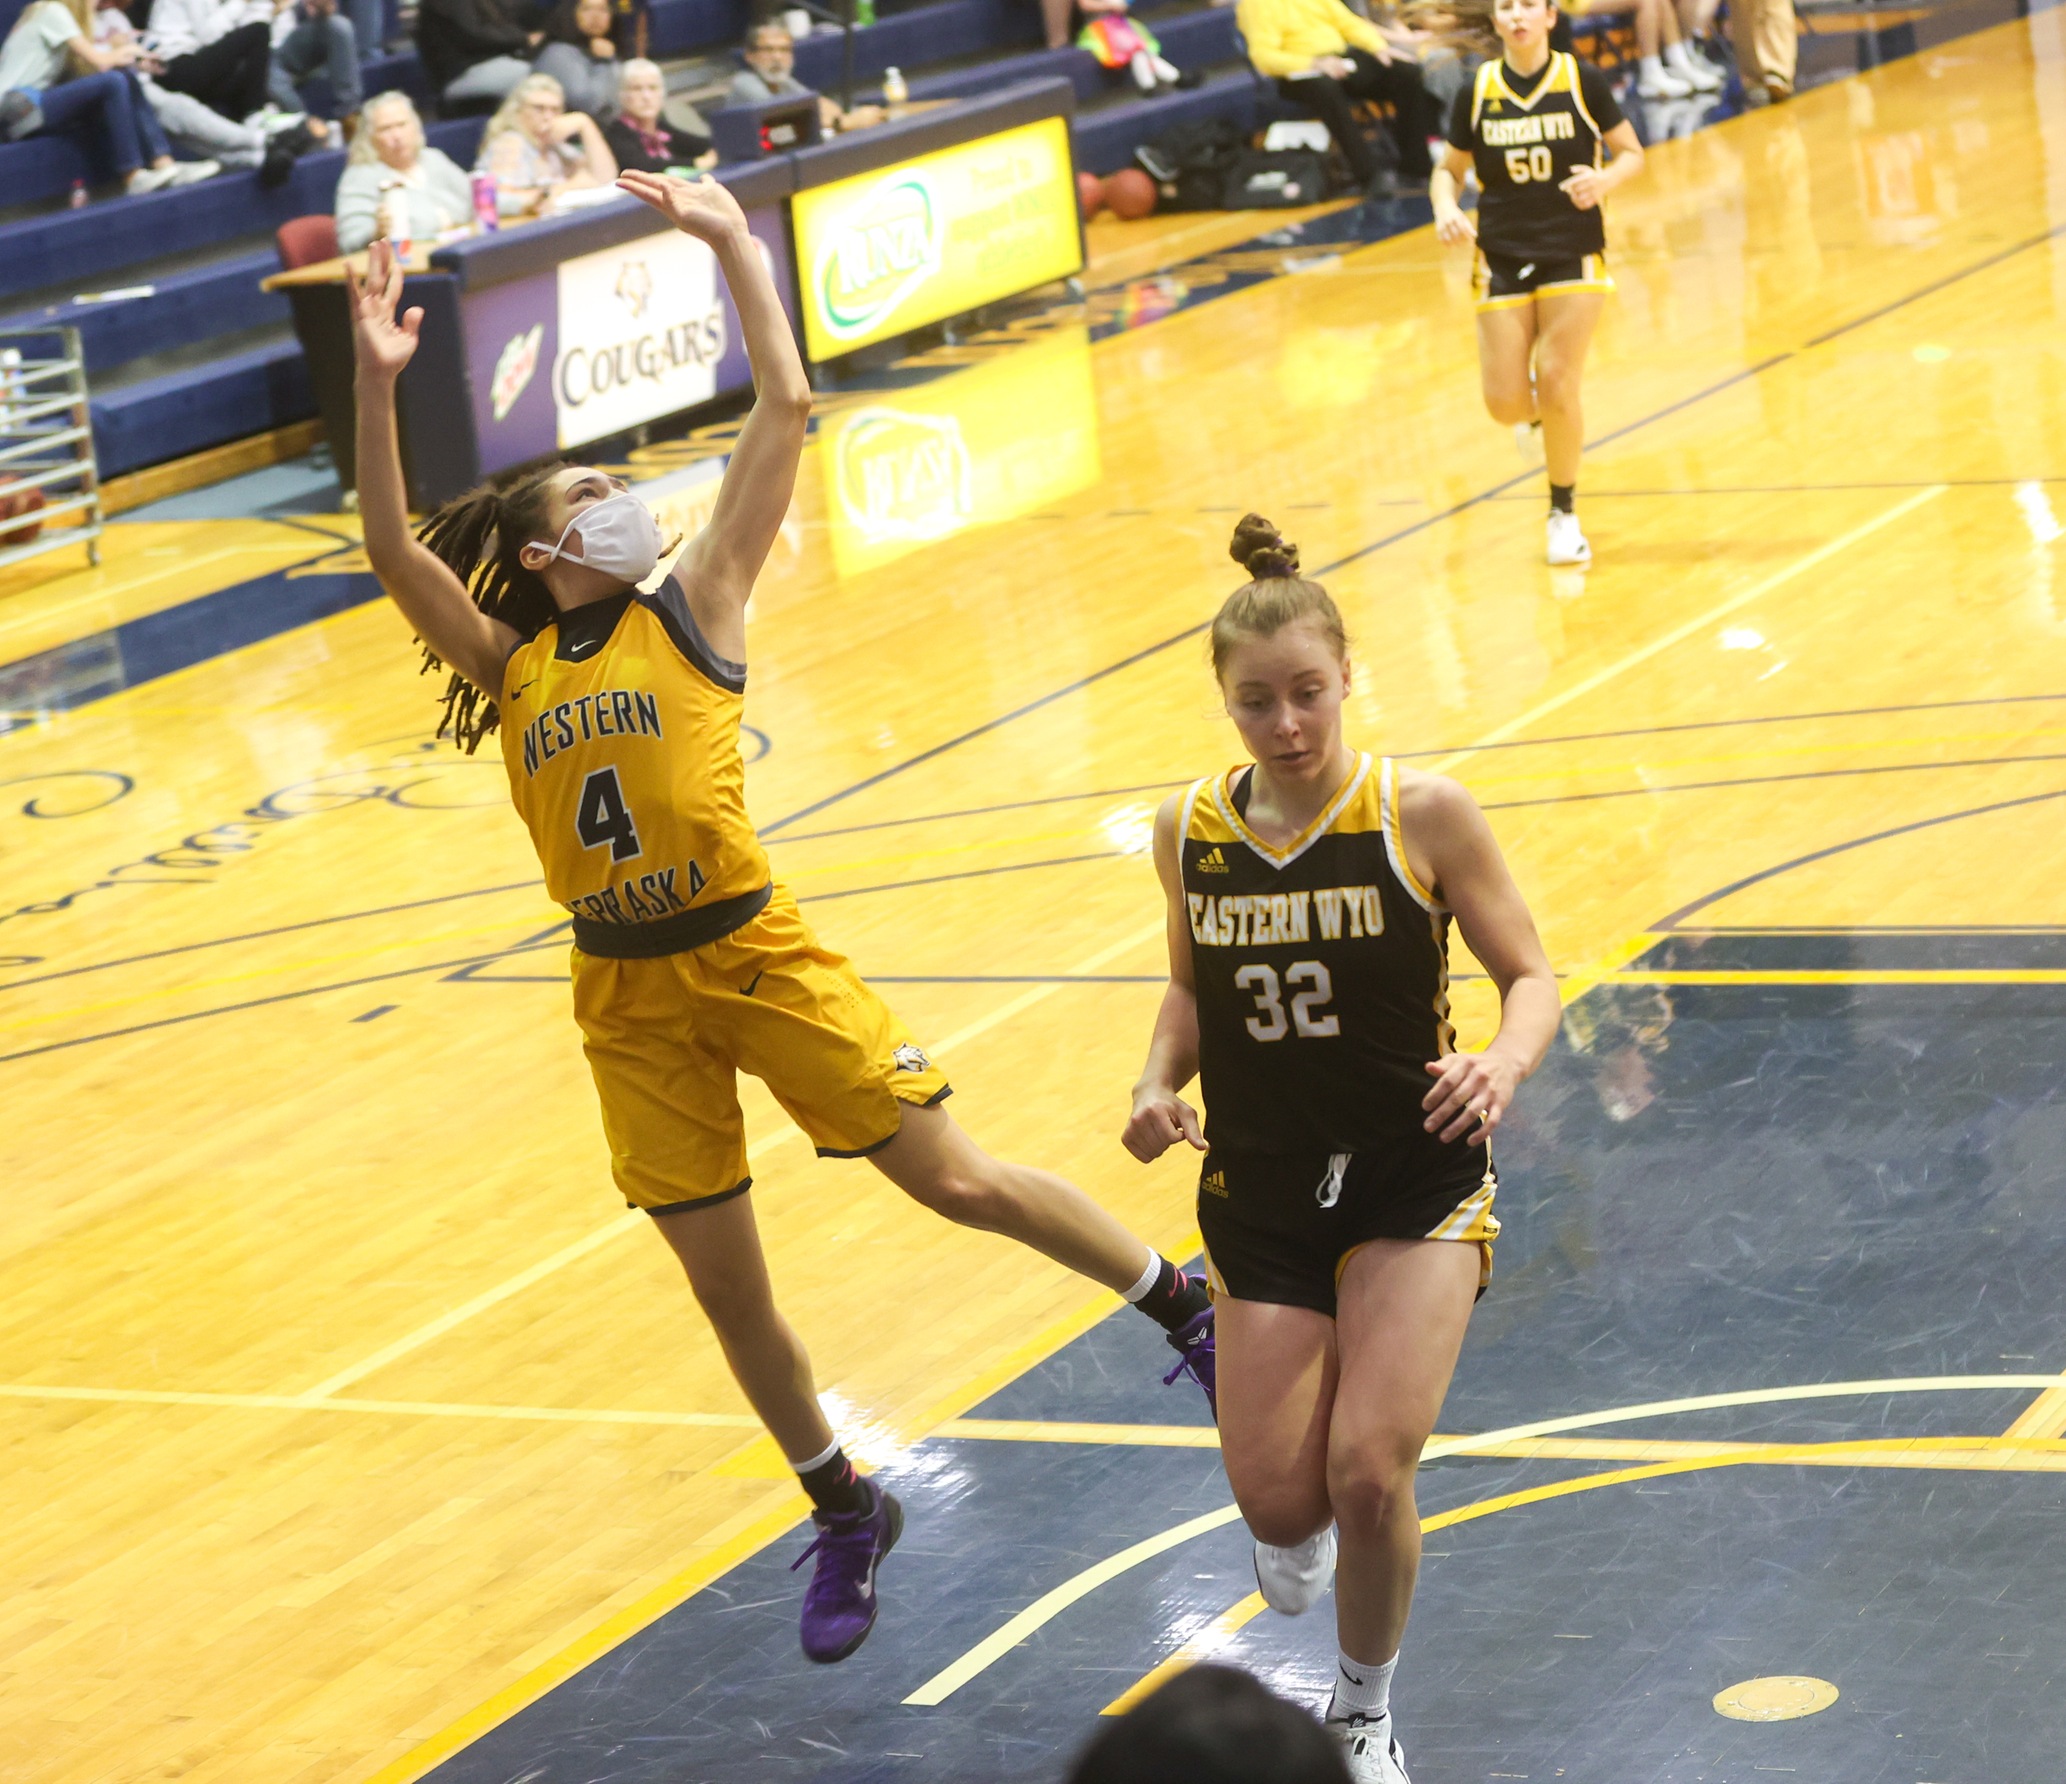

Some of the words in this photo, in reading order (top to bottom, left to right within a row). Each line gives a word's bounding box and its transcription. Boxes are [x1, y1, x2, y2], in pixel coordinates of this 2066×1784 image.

[1504, 145, 1553, 184] 50
[560, 312, 721, 407] COUGARS
[523, 690, 663, 779] WESTERN
[575, 764, 643, 865] 4
[1196, 862, 1230, 874] adidas
[1187, 891, 1310, 946] EASTERN
[1313, 884, 1385, 941] WYO
[1234, 960, 1341, 1042] 32
